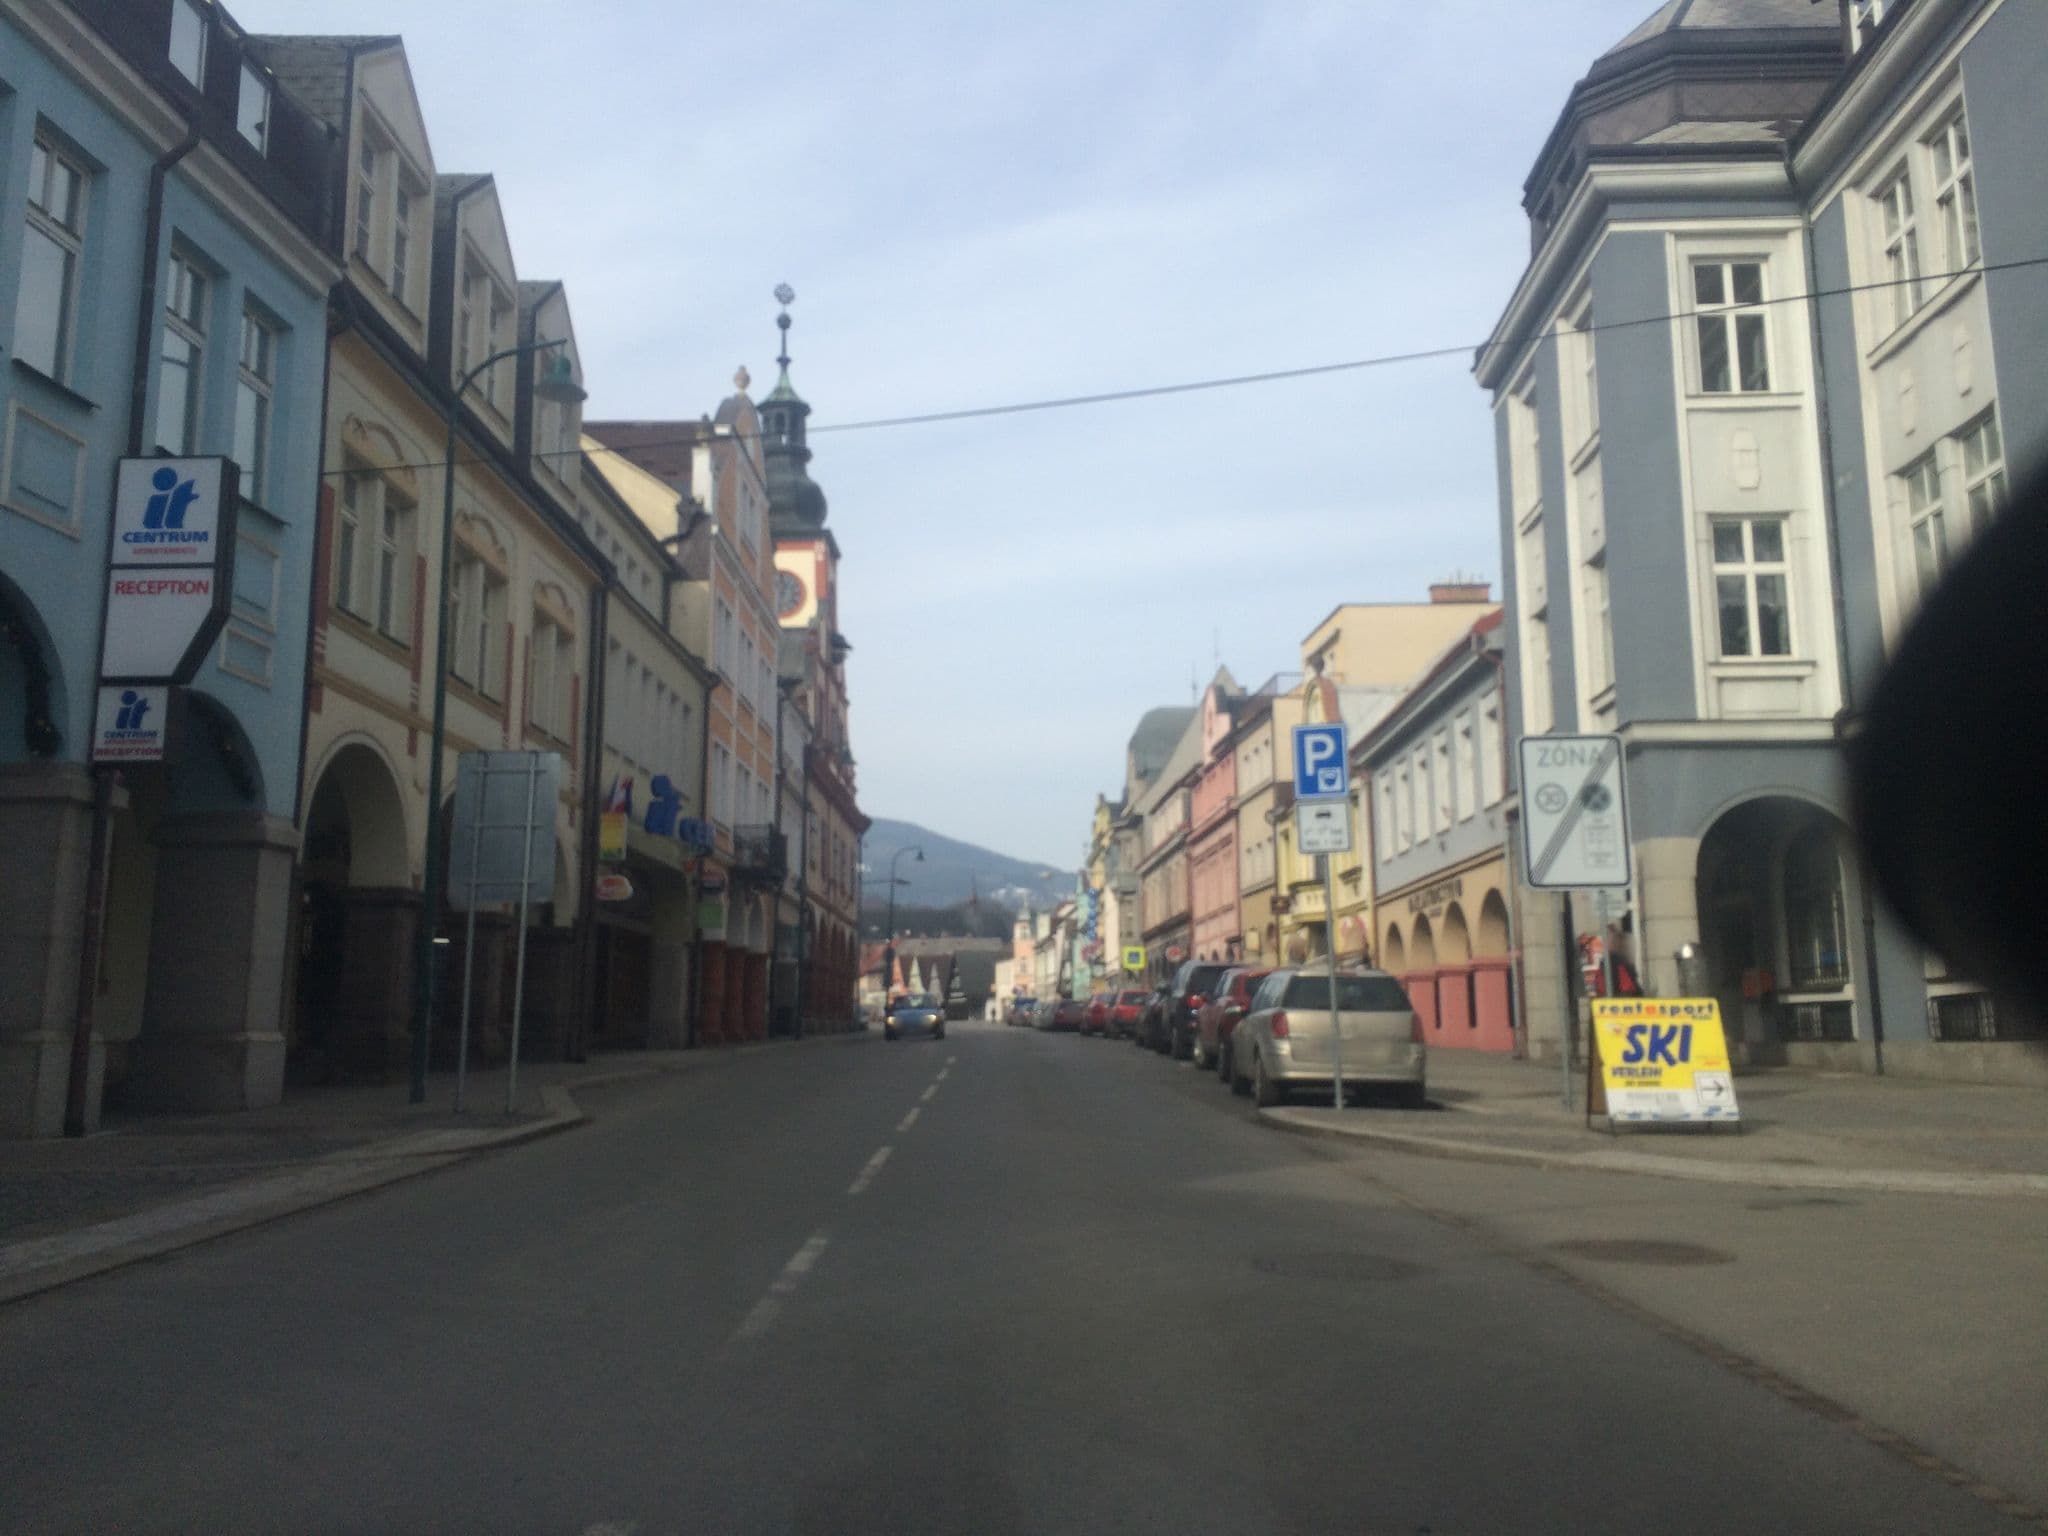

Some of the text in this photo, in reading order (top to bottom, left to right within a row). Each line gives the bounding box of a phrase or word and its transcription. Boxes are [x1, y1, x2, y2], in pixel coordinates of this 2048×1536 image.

[122, 531, 209, 543] CENTRUM
[115, 580, 209, 595] RECEPTION
[1304, 733, 1336, 776] P
[1622, 1025, 1692, 1066] SKI
